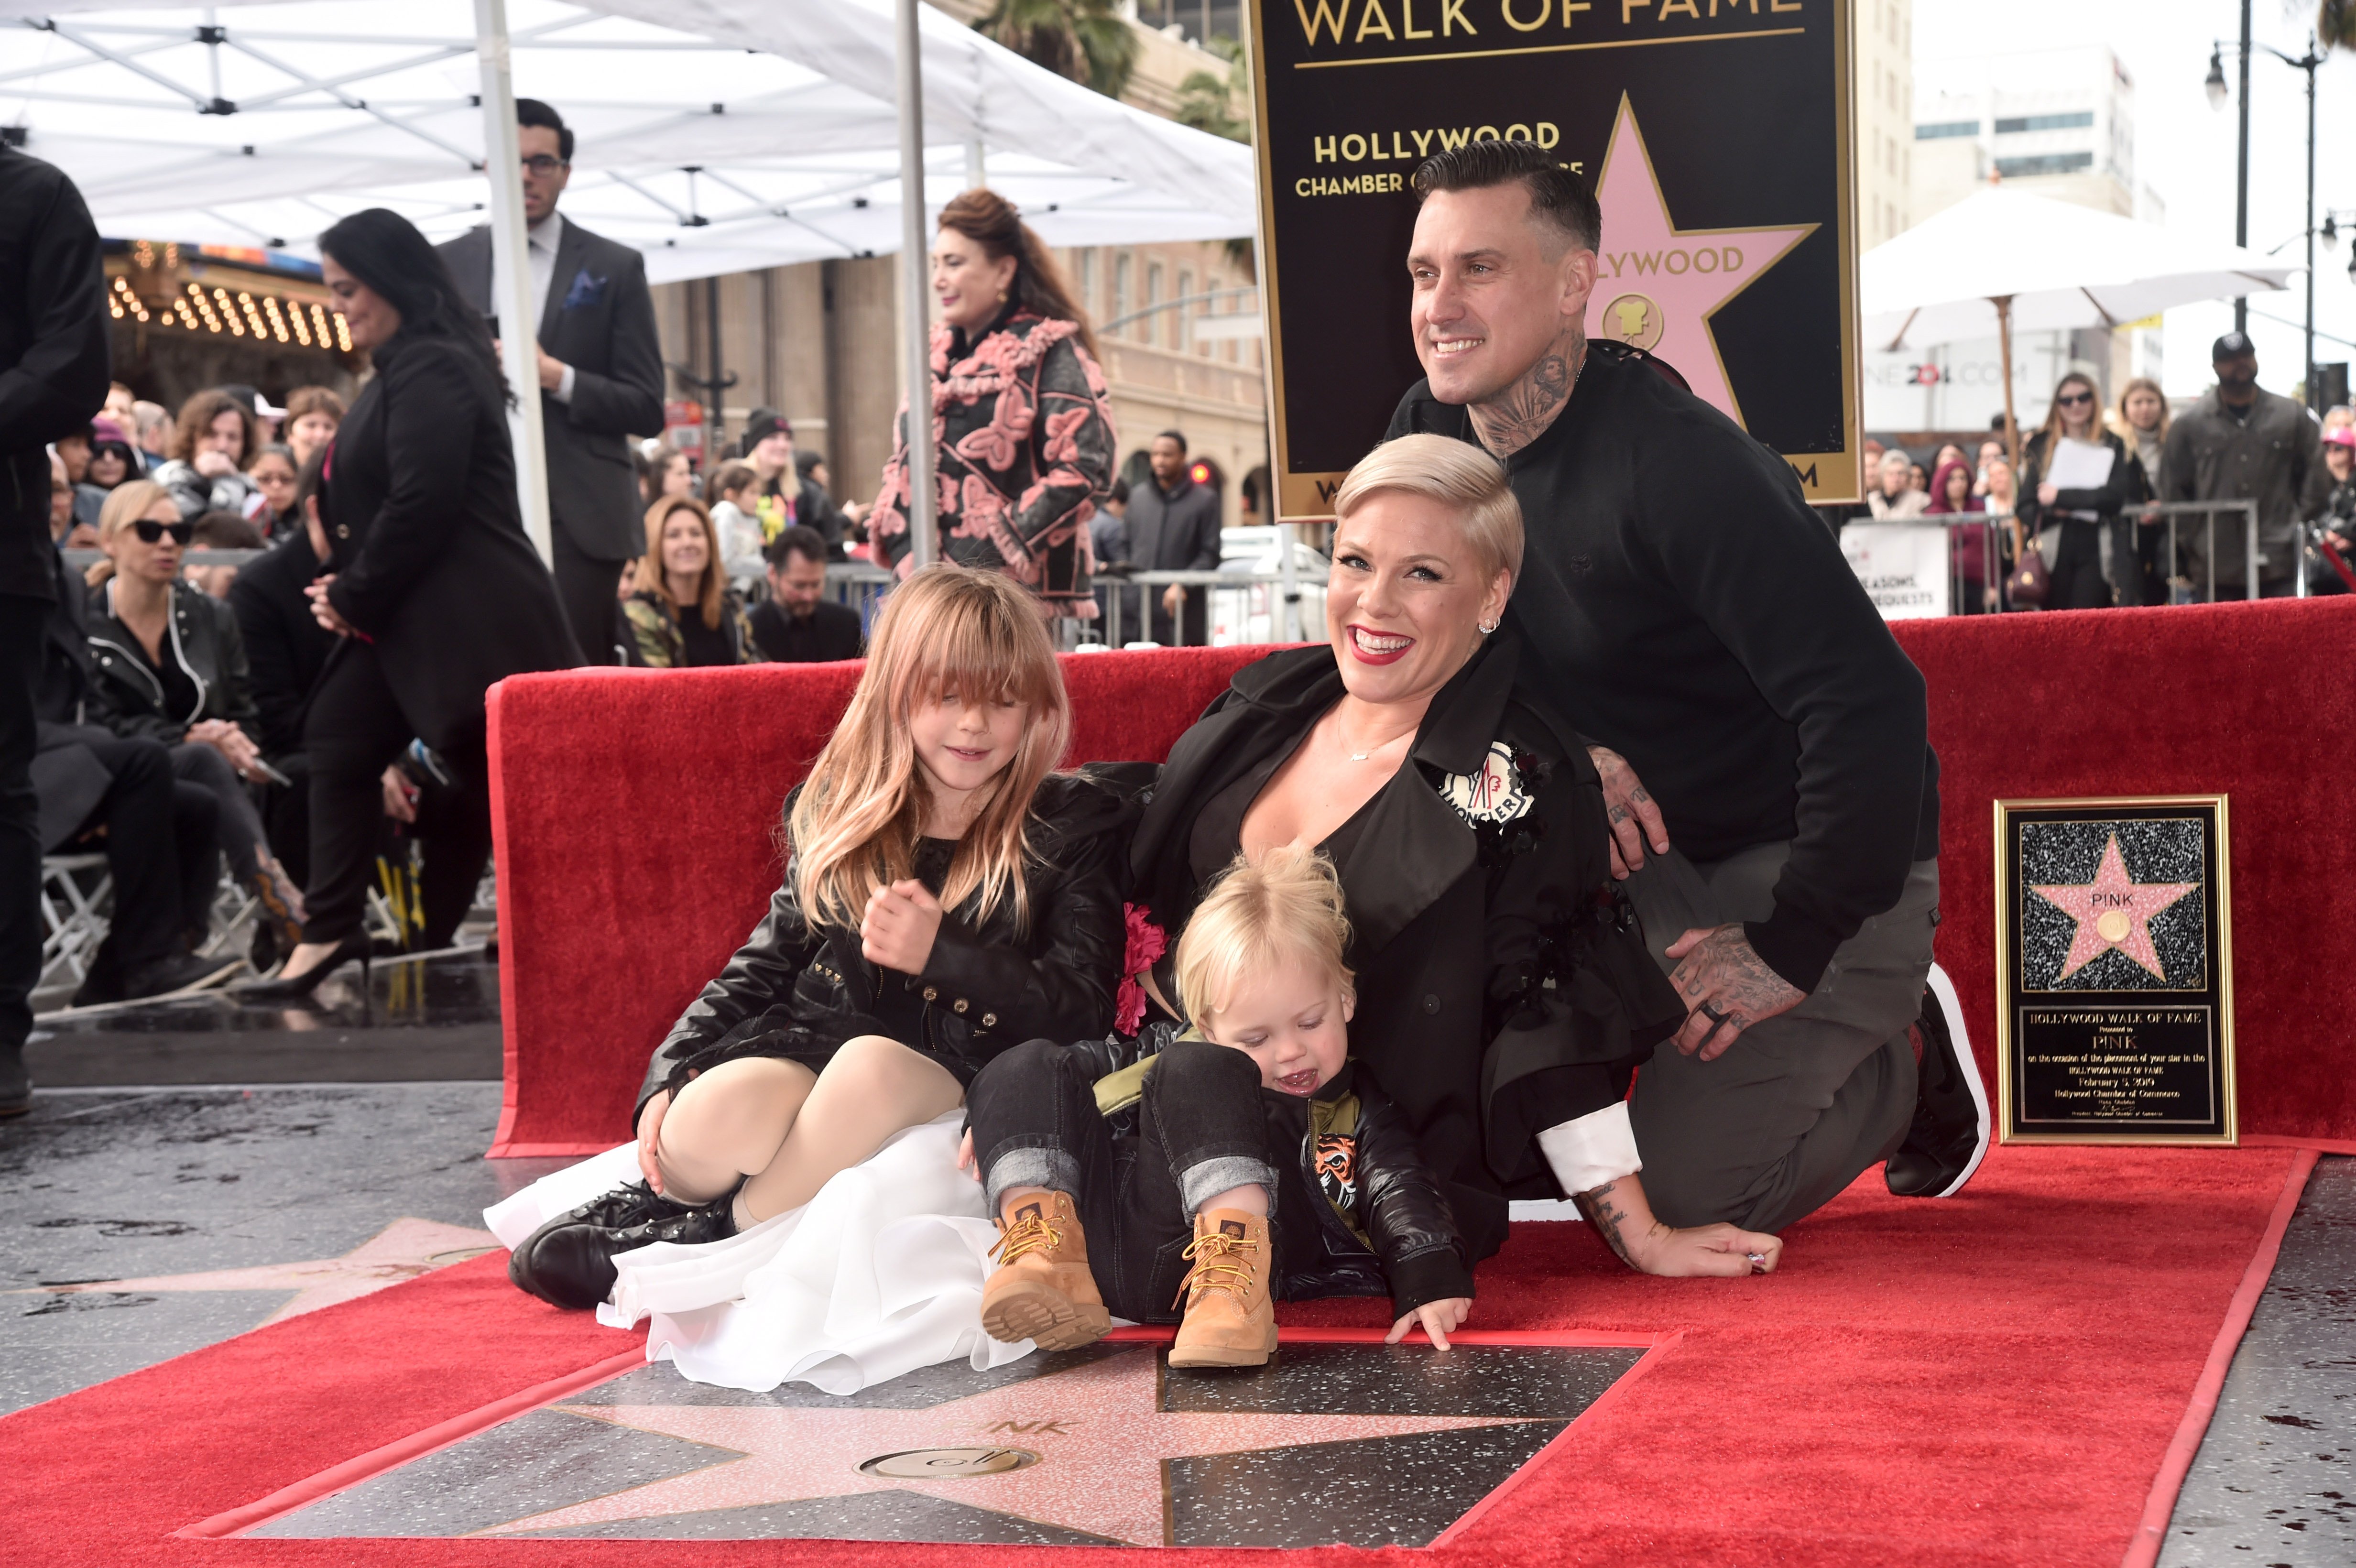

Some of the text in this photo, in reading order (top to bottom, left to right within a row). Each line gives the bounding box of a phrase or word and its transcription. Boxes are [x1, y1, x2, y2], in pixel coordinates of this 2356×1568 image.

[1295, 0, 1478, 47] WALK
[1501, 0, 1591, 32] OF
[1295, 173, 1403, 197] CHAMBER
[2092, 893, 2134, 906] P!NK
[2030, 1013, 2202, 1024] HOLLYWOOD WALK OF FAME
[2093, 1035, 2138, 1049] P!NK
[2039, 1054, 2051, 1063] the
[2052, 1054, 2079, 1063] occasion
[2081, 1053, 2088, 1063] of
[2091, 1053, 2102, 1062] the
[2140, 1053, 2148, 1062] of
[2150, 1055, 2166, 1065] your
[2168, 1054, 2181, 1062] star
[2183, 1053, 2191, 1062] in
[2193, 1053, 2205, 1062] the
[2069, 1066, 2164, 1075] HOLLYWOOD WALK OF FAME
[2079, 1078, 2118, 1089] February
[2132, 1078, 2155, 1087] 2019
[2055, 1089, 2181, 1099] Hollywood Chamber of Commerce
